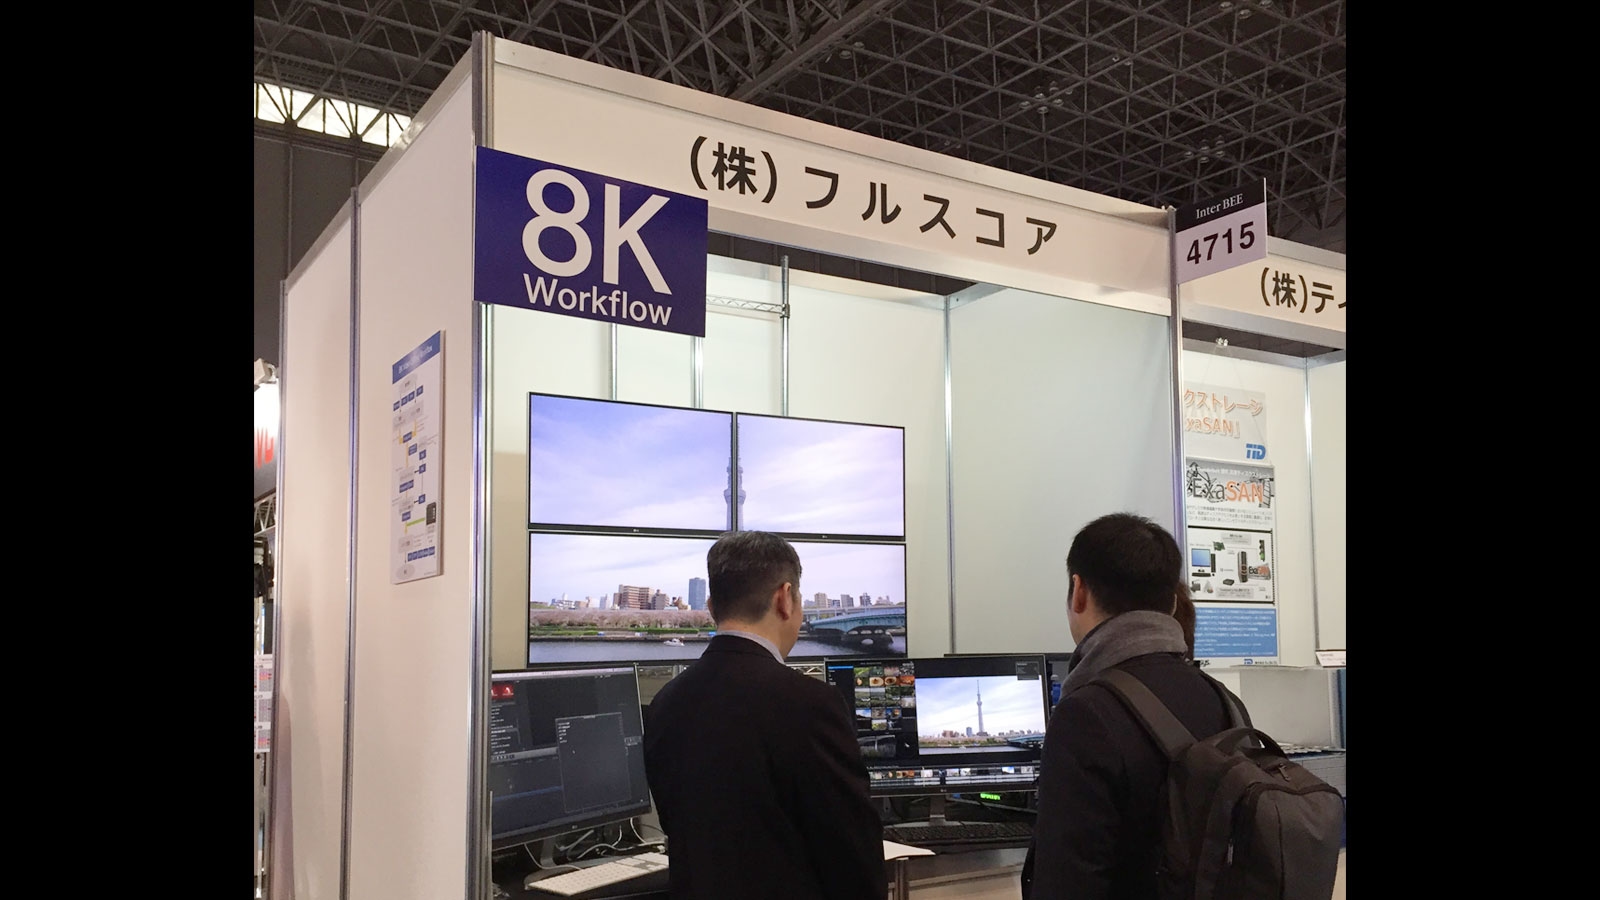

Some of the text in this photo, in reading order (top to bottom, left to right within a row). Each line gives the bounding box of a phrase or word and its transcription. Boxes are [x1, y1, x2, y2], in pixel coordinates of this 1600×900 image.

[1195, 193, 1244, 219] Inter BEE
[522, 168, 672, 295] 8K
[1187, 221, 1255, 265] 4715
[523, 273, 672, 326] Workflow
[1193, 478, 1264, 503] ExaSAN
